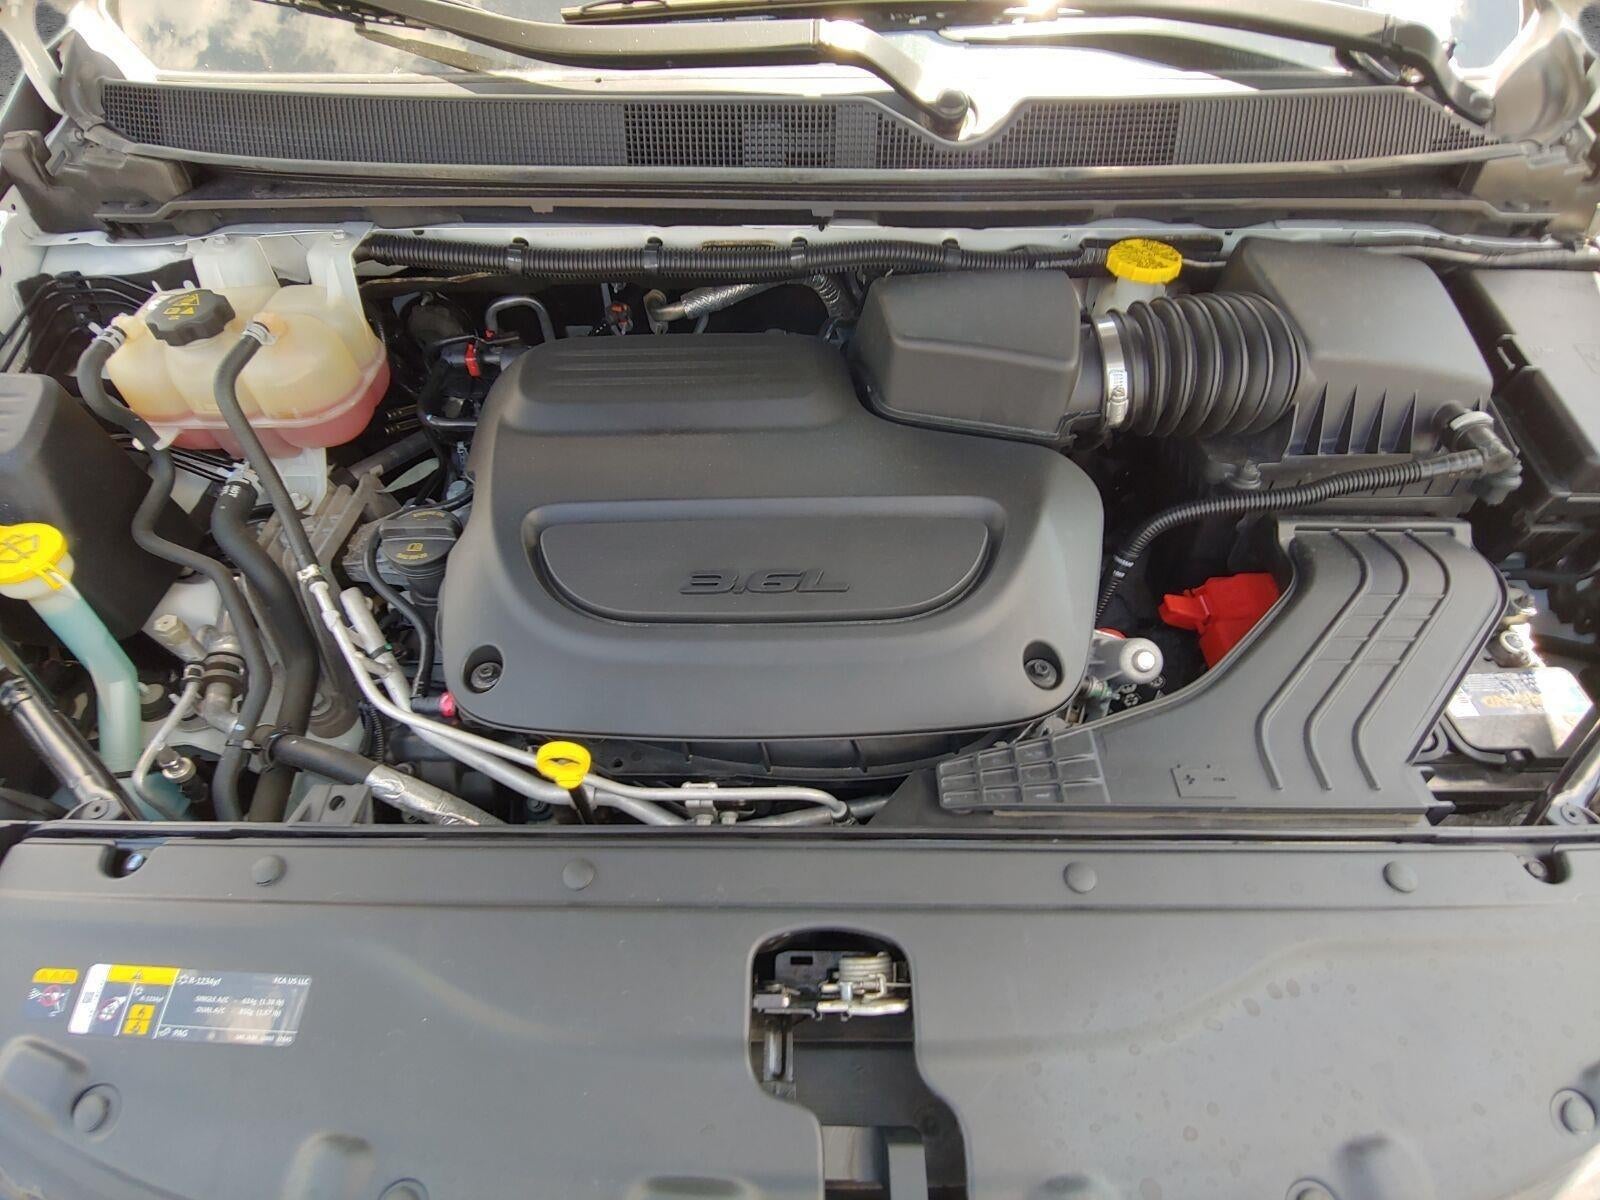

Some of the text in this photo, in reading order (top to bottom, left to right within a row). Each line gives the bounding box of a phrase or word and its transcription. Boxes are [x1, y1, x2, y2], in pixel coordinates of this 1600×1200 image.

[680, 569, 850, 594] 3.6L
[188, 976, 222, 987] R-1234yf
[273, 976, 311, 986] FCA US LLC
[172, 1028, 189, 1038] PAG
